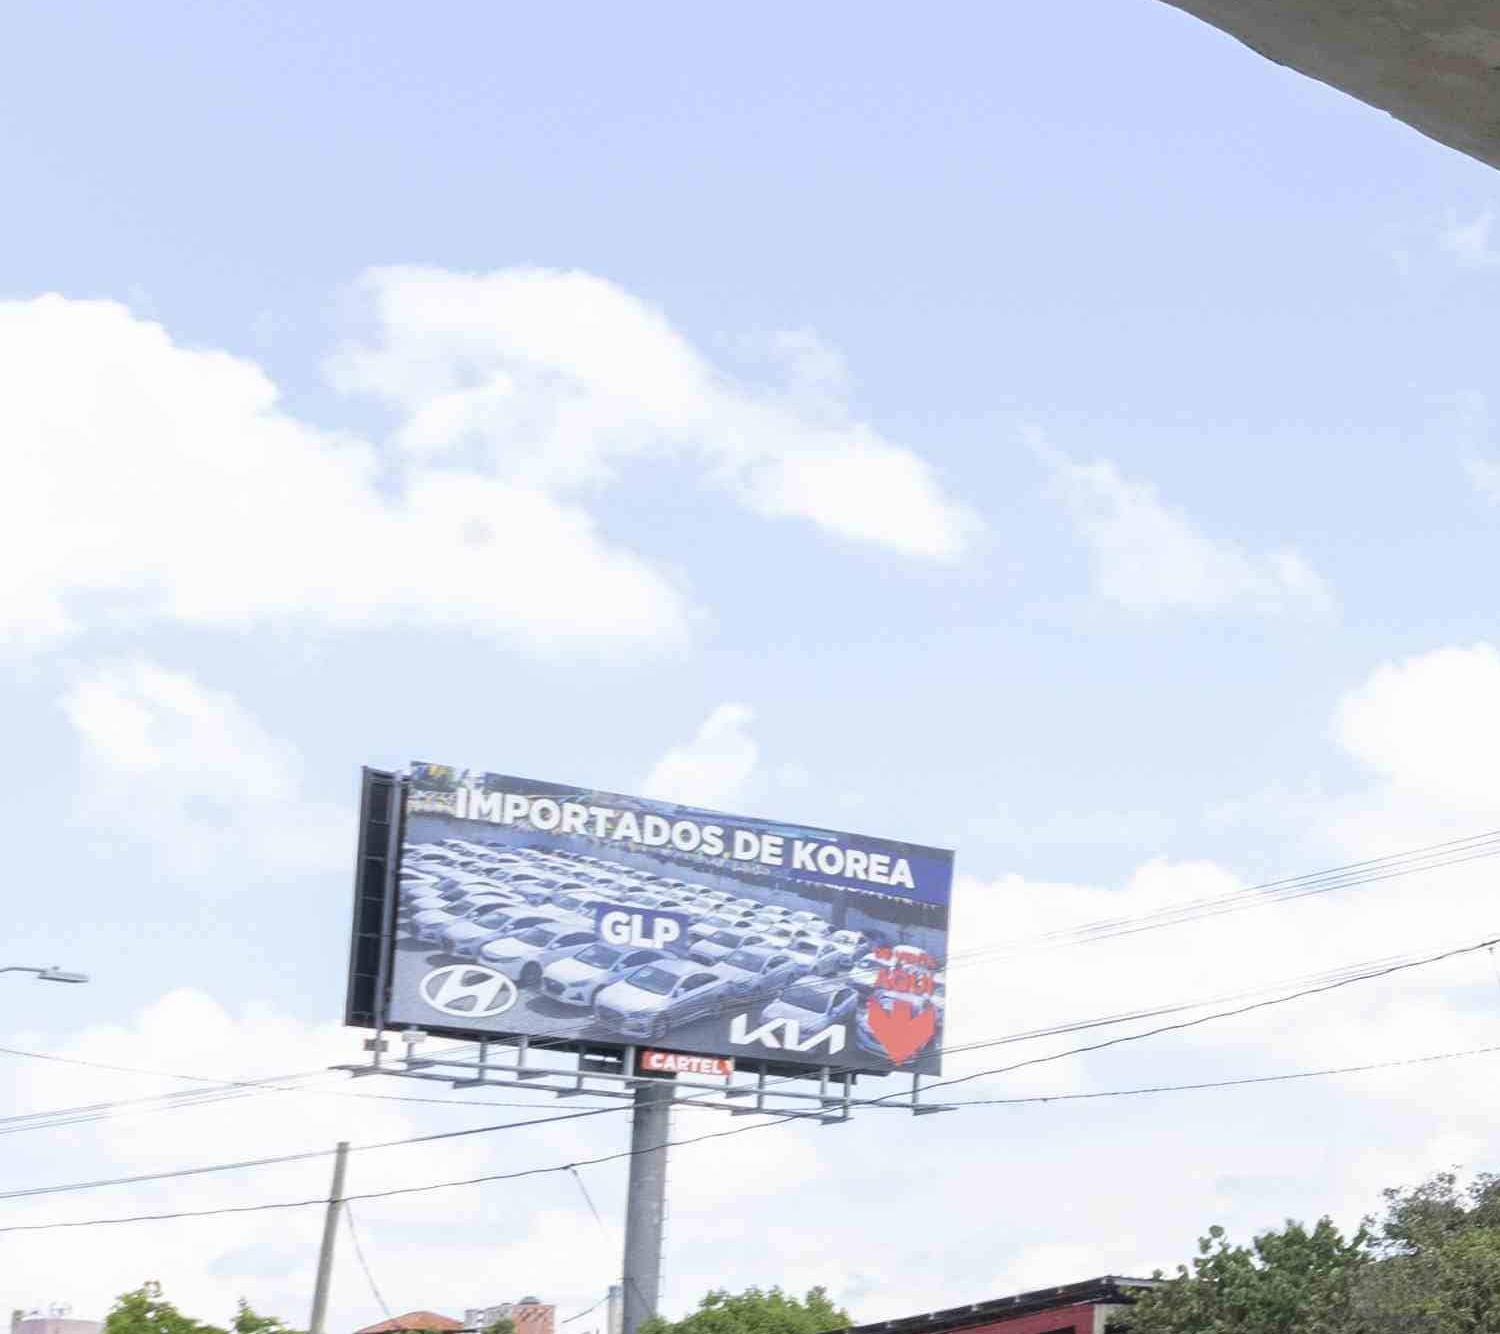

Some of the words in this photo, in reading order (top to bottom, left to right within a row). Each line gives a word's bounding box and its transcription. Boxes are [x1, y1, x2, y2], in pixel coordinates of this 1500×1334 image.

[455, 785, 725, 857] IMPORTADOS
[733, 830, 783, 867] DE
[792, 840, 915, 889] KOREA
[601, 911, 680, 949] GLP
[729, 1013, 846, 1055] KIA
